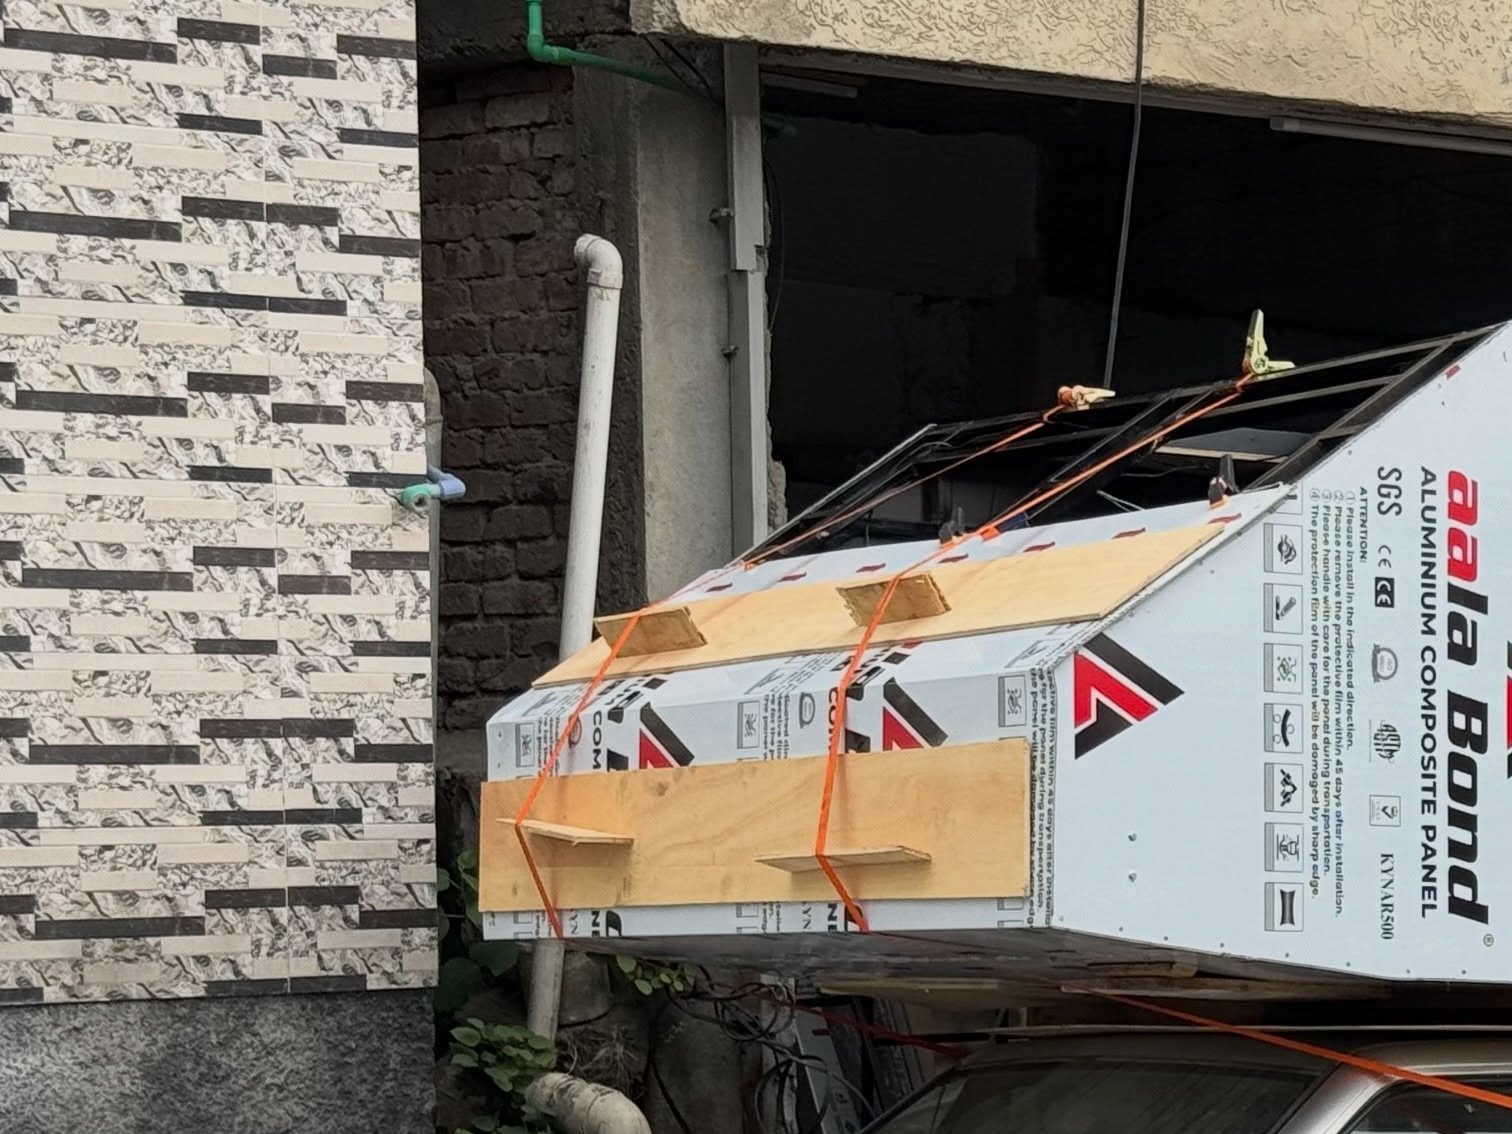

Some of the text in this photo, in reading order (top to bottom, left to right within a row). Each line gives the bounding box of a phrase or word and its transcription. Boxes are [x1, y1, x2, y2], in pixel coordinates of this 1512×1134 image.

[1376, 467, 1402, 517] SGS
[1322, 505, 1331, 546] Please
[1334, 505, 1343, 547] Please
[1359, 486, 1368, 563] ATTENTION:
[1322, 548, 1331, 592] handle
[1322, 595, 1331, 622] with
[1334, 600, 1343, 621] the
[1346, 507, 1355, 750] Please install in the indicated direction.
[1323, 656, 1331, 672] for
[1332, 623, 1343, 688] protective
[1308, 504, 1320, 899] The protection film of the panel will be damaged by sharp edge.
[1323, 675, 1331, 696] the
[1334, 690, 1343, 714] film
[1420, 466, 1436, 919] ALUMINIUM COMPOSITE PANEL
[1446, 470, 1488, 926] aala Bond
[1320, 698, 1331, 734] panel
[1335, 717, 1343, 756] within
[1320, 737, 1331, 778] during
[1335, 759, 1343, 774] 45
[1332, 777, 1343, 808] days
[1335, 810, 1343, 841] after
[1379, 853, 1394, 940] KYNAR500
